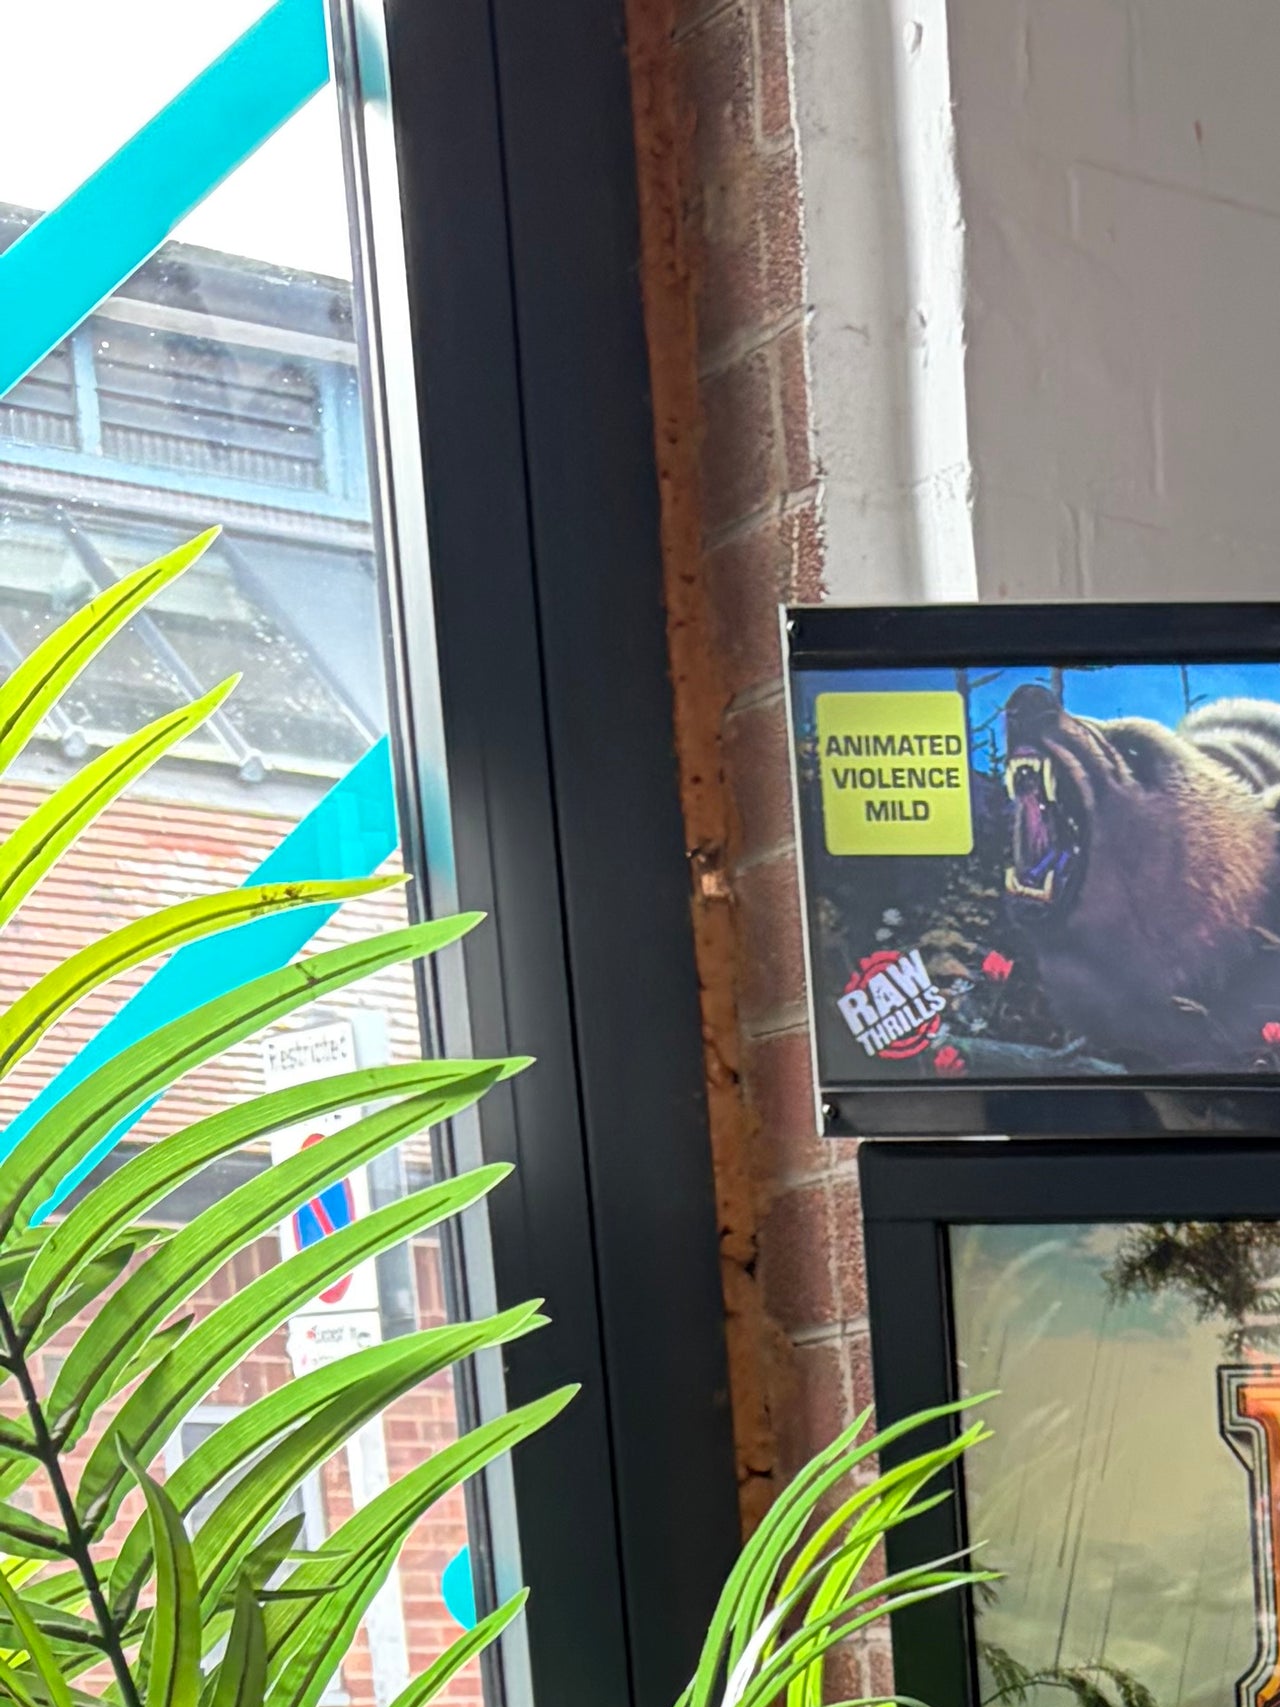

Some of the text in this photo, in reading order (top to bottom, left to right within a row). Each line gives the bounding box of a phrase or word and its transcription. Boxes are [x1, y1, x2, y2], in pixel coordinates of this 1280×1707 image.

[825, 734, 962, 757] ANIMATED
[832, 767, 961, 789] VIOLENCE
[865, 800, 930, 821] MILD
[837, 949, 931, 1035] RAW
[856, 985, 946, 1056] THRILLS
